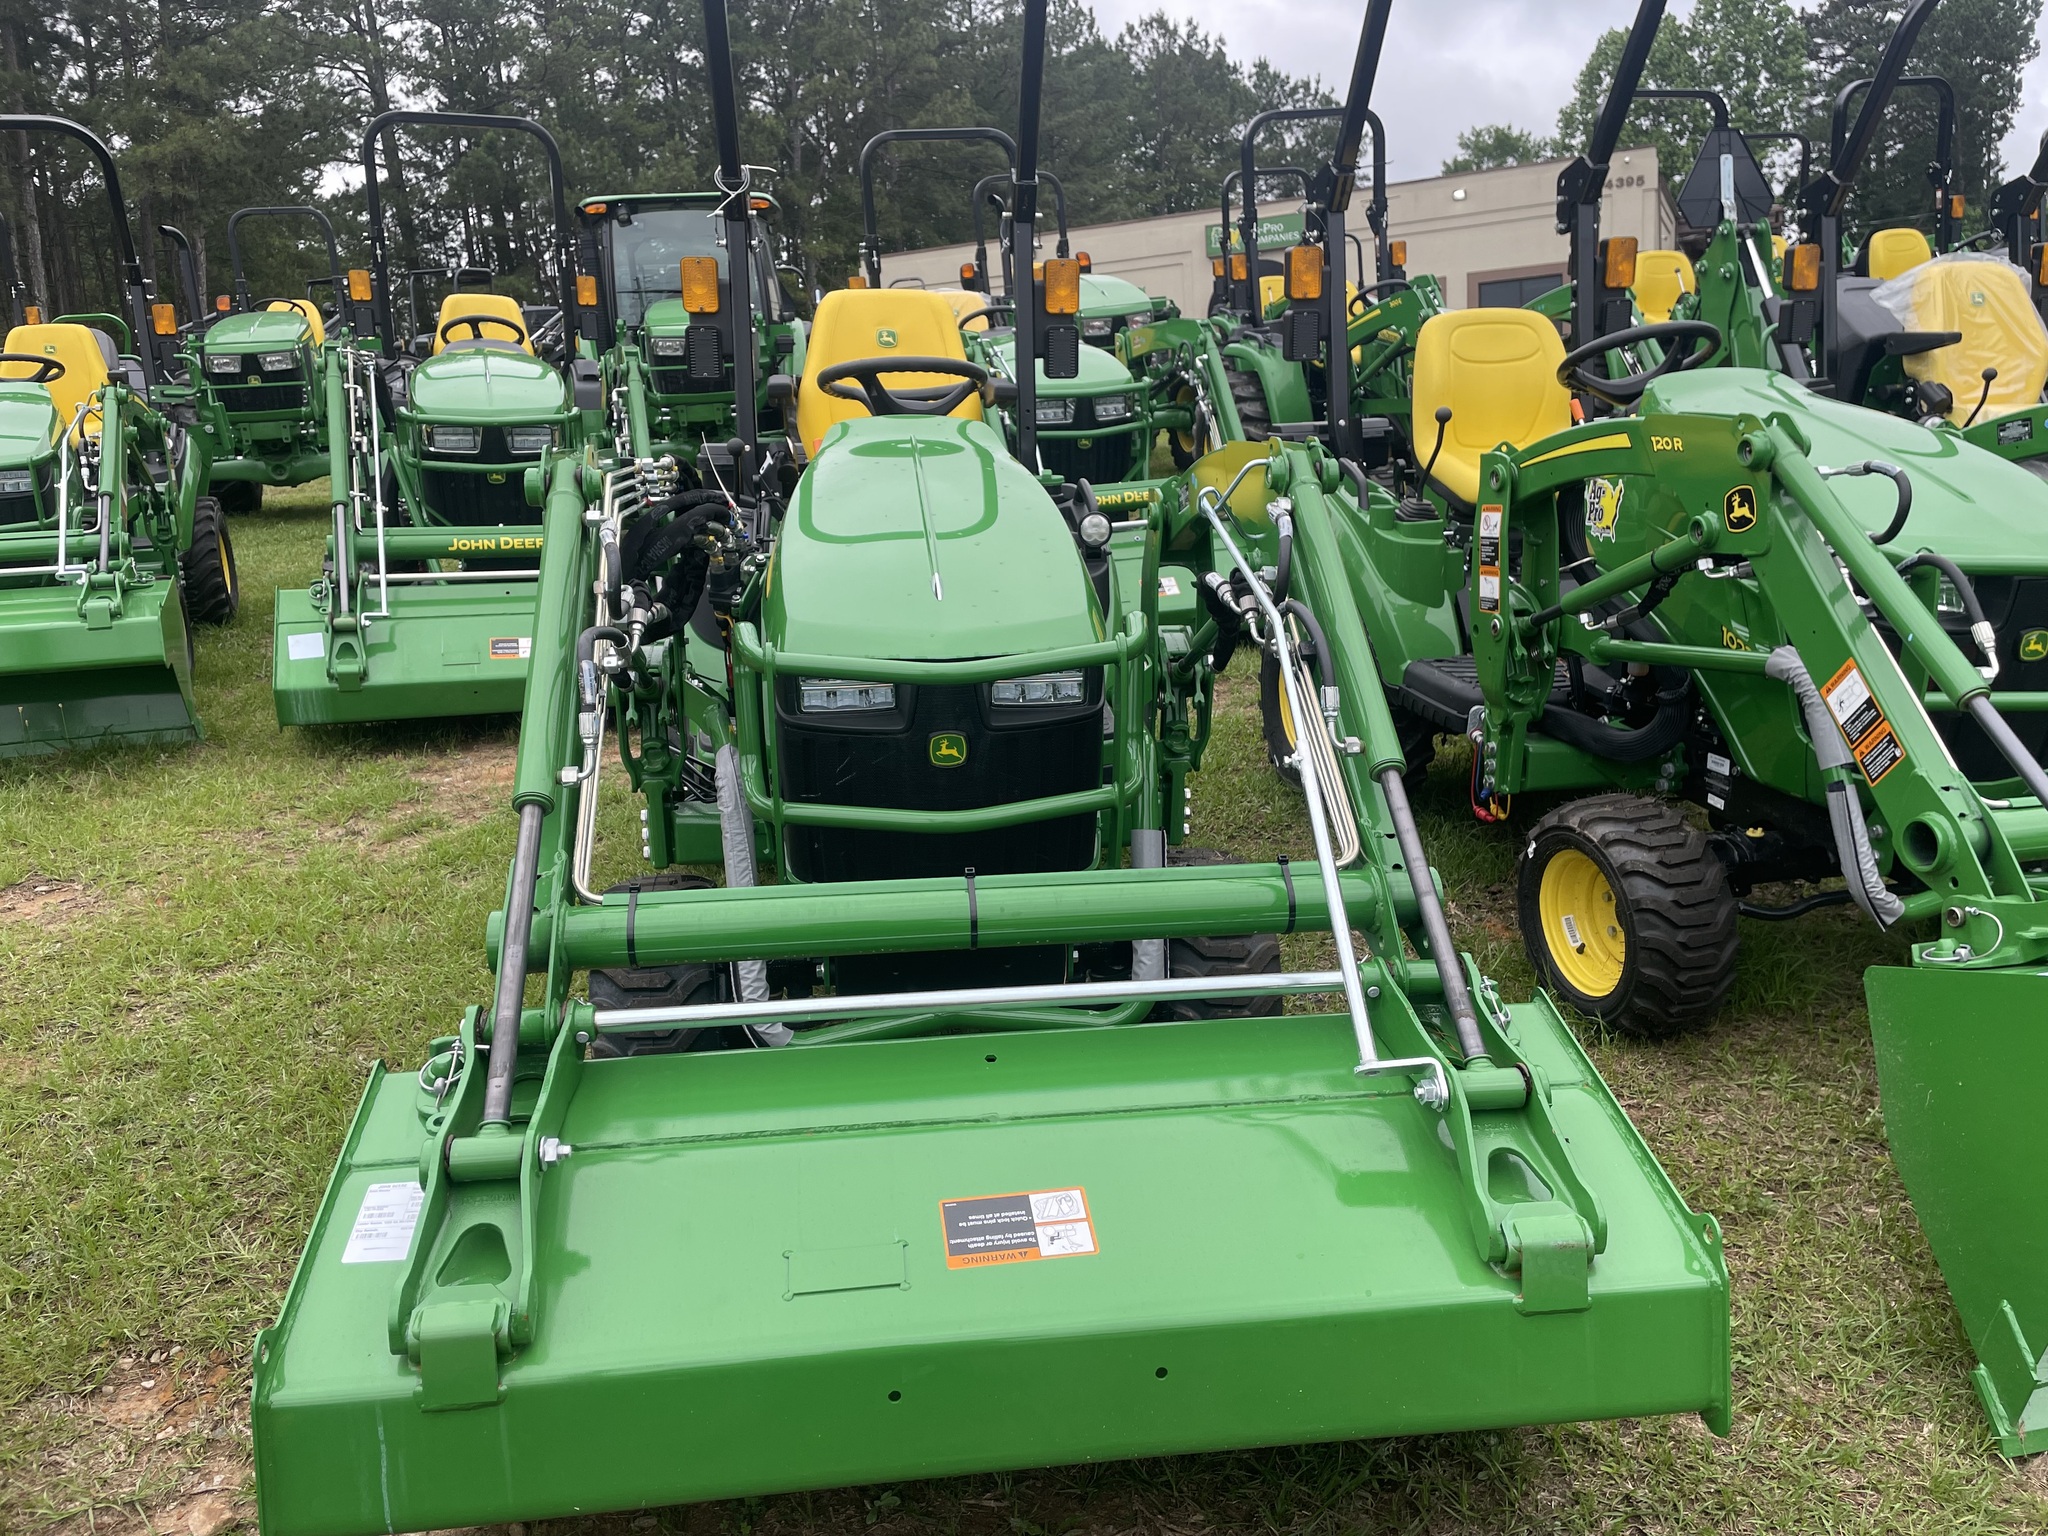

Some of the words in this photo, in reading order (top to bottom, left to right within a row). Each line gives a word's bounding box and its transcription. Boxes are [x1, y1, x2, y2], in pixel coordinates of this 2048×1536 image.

[1605, 175, 1645, 190] 4395
[1257, 222, 1285, 234] -PRO
[1257, 230, 1300, 244] MPANIES
[1095, 493, 1122, 505] OHN
[1123, 490, 1150, 503] DEE
[1588, 502, 1604, 521] Pro
[448, 538, 496, 551] JOHN
[499, 536, 544, 550] DEER
[1830, 664, 1852, 689] WARNING
[1864, 727, 1888, 751] WARNING
[1012, 1230, 1035, 1238] caused
[962, 1252, 1016, 1264] WARNING
